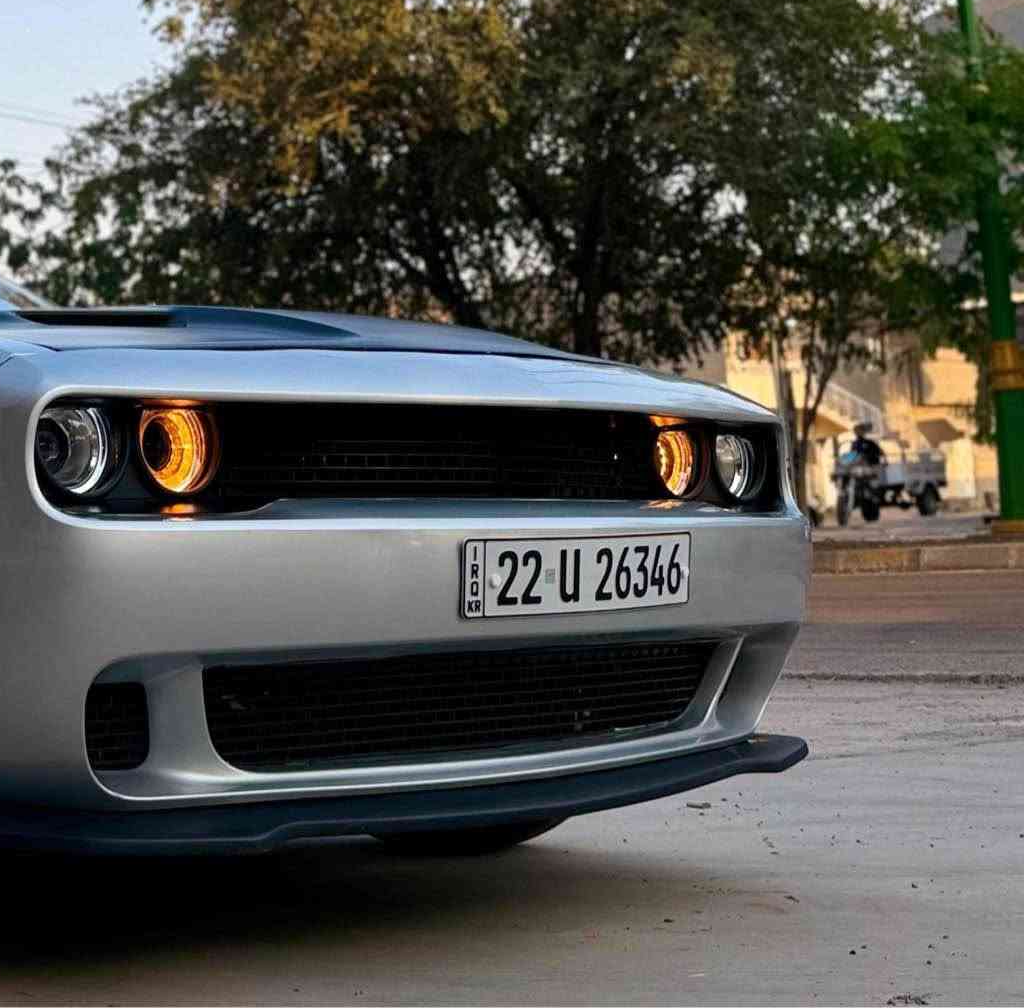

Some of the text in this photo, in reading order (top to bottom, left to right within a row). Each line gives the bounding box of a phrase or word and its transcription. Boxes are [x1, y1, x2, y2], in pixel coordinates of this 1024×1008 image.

[497, 544, 681, 606] 22 U 26346
[467, 600, 481, 613] KR
